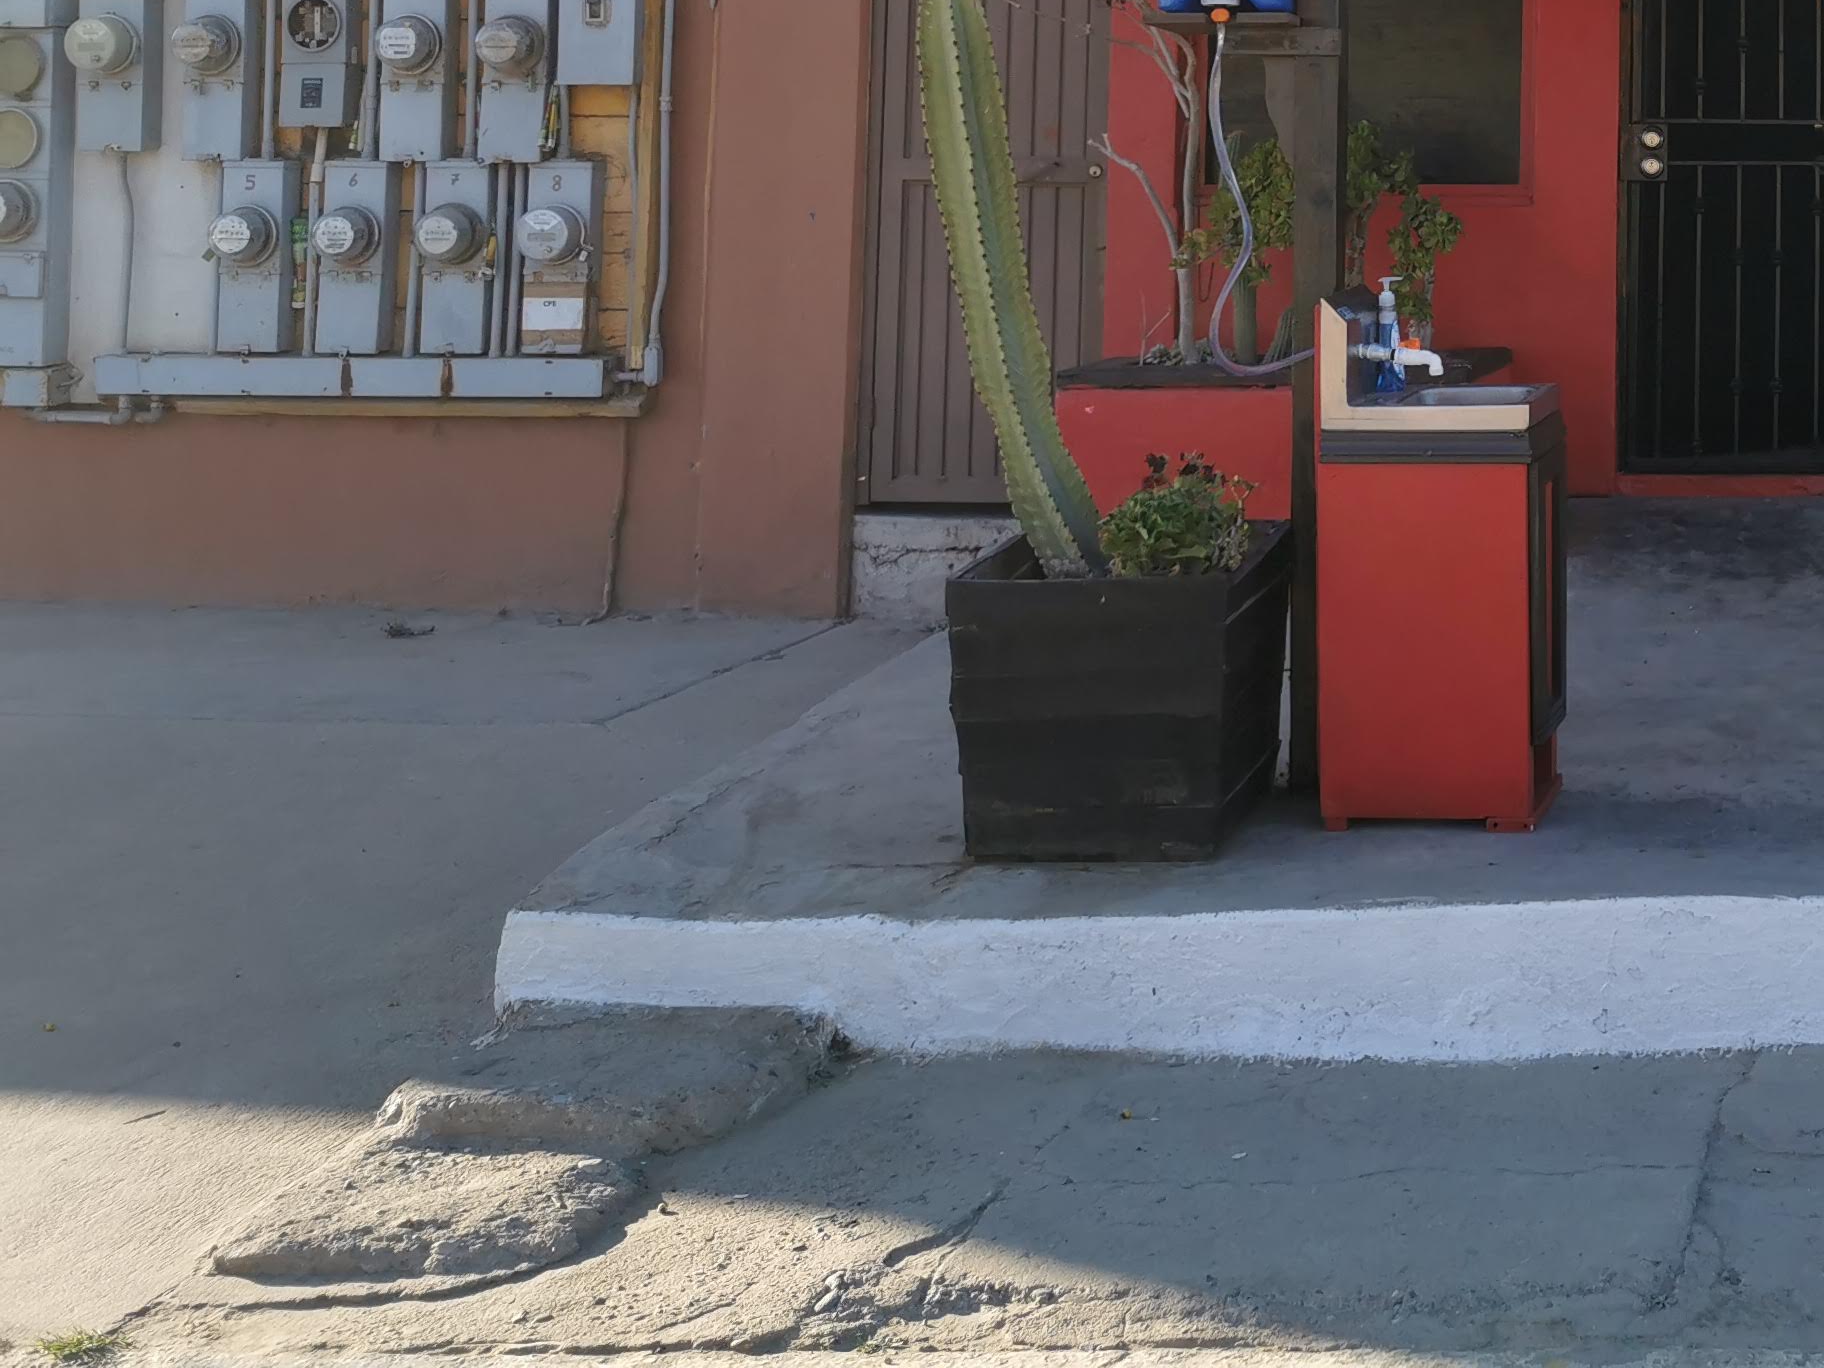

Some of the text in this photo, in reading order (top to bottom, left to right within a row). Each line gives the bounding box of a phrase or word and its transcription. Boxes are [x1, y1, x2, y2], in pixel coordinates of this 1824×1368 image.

[244, 174, 257, 191] 5
[347, 173, 358, 187] 6
[552, 174, 562, 192] 8
